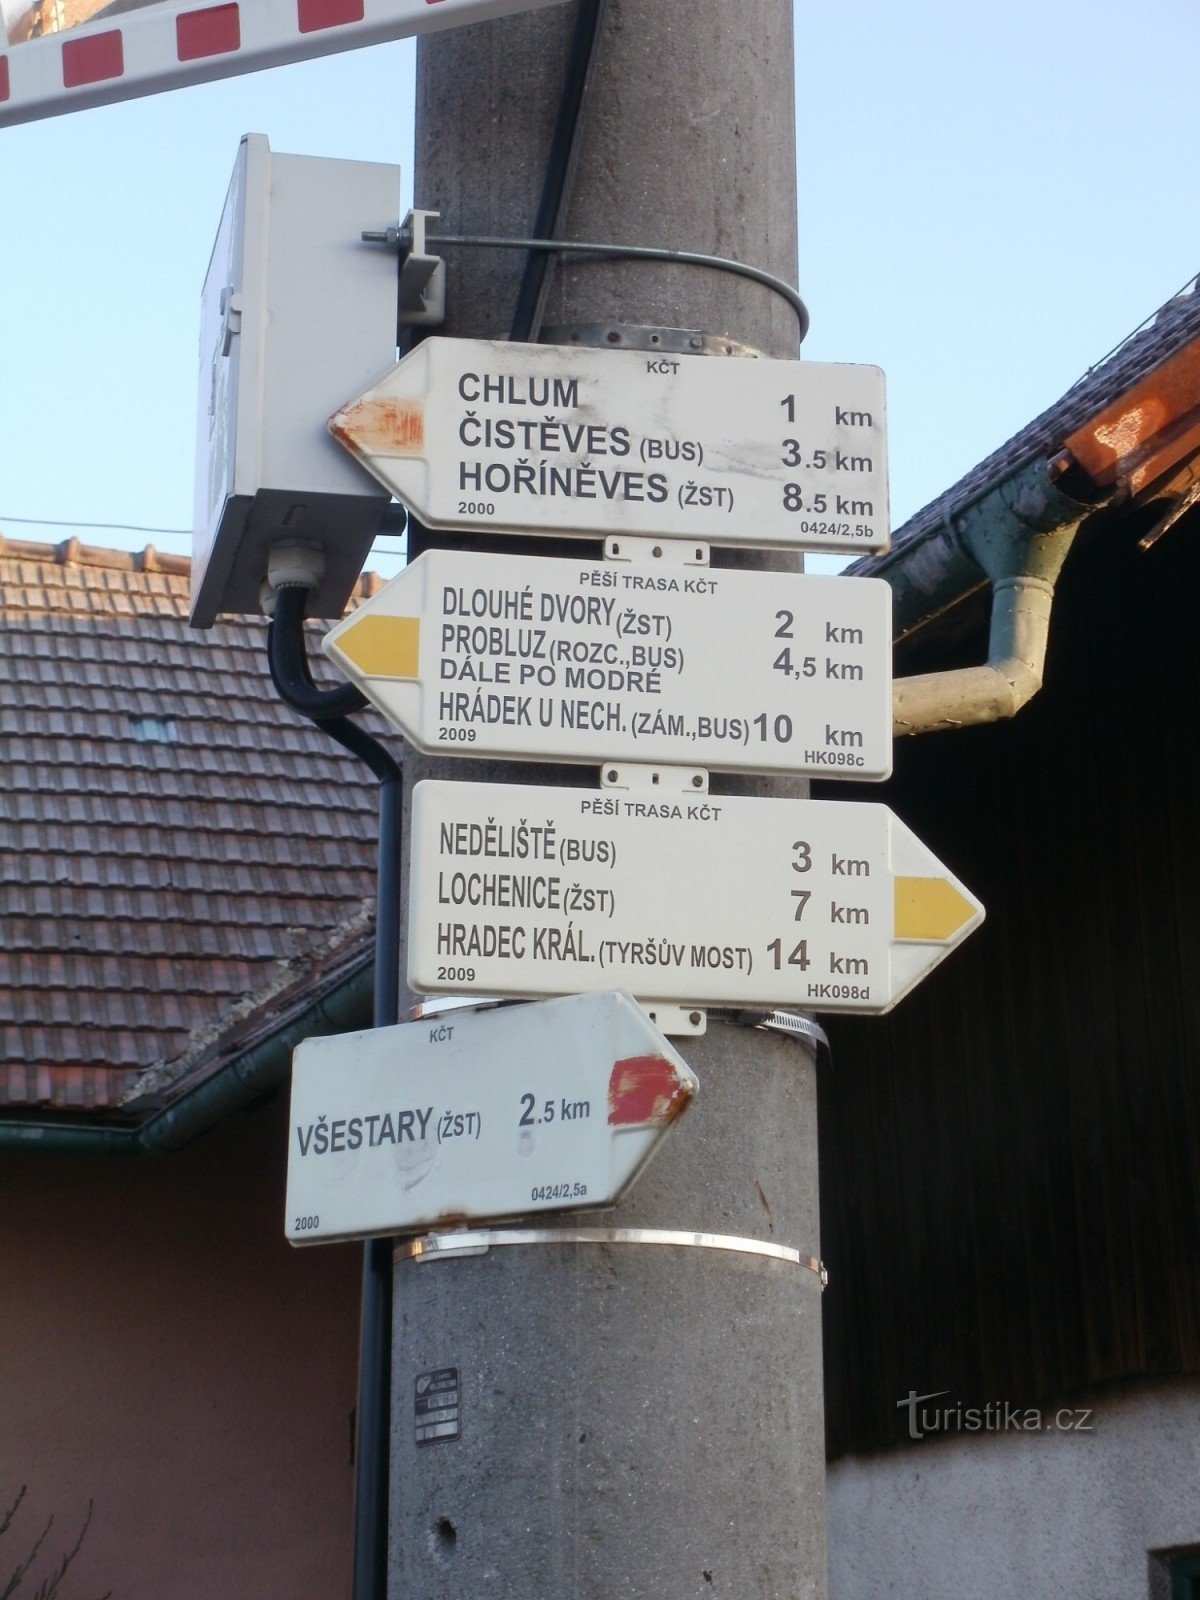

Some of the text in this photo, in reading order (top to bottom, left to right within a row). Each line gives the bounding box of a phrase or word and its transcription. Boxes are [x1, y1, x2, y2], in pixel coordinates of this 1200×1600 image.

[647, 359, 680, 374] KČT
[459, 373, 872, 426] CHLUM 1 km
[460, 411, 630, 456] ČISTĚVES
[640, 438, 703, 466] (BUS)
[836, 451, 872, 472] km
[460, 459, 668, 502] HOŘÍNĚVES
[678, 485, 733, 512] (ŽST)
[837, 495, 873, 516] km
[459, 502, 873, 537] 2000 0424/2,5b
[580, 570, 718, 594] PĚŠÍ TRASA KČT
[443, 585, 862, 644] DLOUHÉ DVORY (ŽST) 2 km
[441, 656, 661, 693] DÁLE PO MODRÉ
[442, 624, 546, 660] PROBLUZ
[826, 658, 862, 680] km
[440, 687, 532, 726] HRÁDEK
[540, 698, 552, 727] U
[561, 700, 626, 731] NECH.
[754, 713, 792, 743] 10
[826, 725, 862, 747] km
[439, 727, 864, 766] 2009 HK098c
[581, 798, 721, 820] PĚŠÍ TRASA KČT
[441, 817, 869, 876] NEDĚLIŠTĚ (BUS) 3 km
[439, 872, 868, 924] LOCHENICE (ŽST) 7 km
[438, 921, 868, 975] HRADEC KRÁL. (TYRŠŮV MOST) 14 km
[438, 967, 869, 999] 2009 HK098d
[430, 1025, 454, 1043] KČT
[297, 1107, 433, 1156] VŠESTARY
[437, 1111, 481, 1144] (ŽST)
[562, 1099, 589, 1120] km
[532, 1183, 586, 1201] 0424/2,5a
[295, 1216, 319, 1231] 2000
